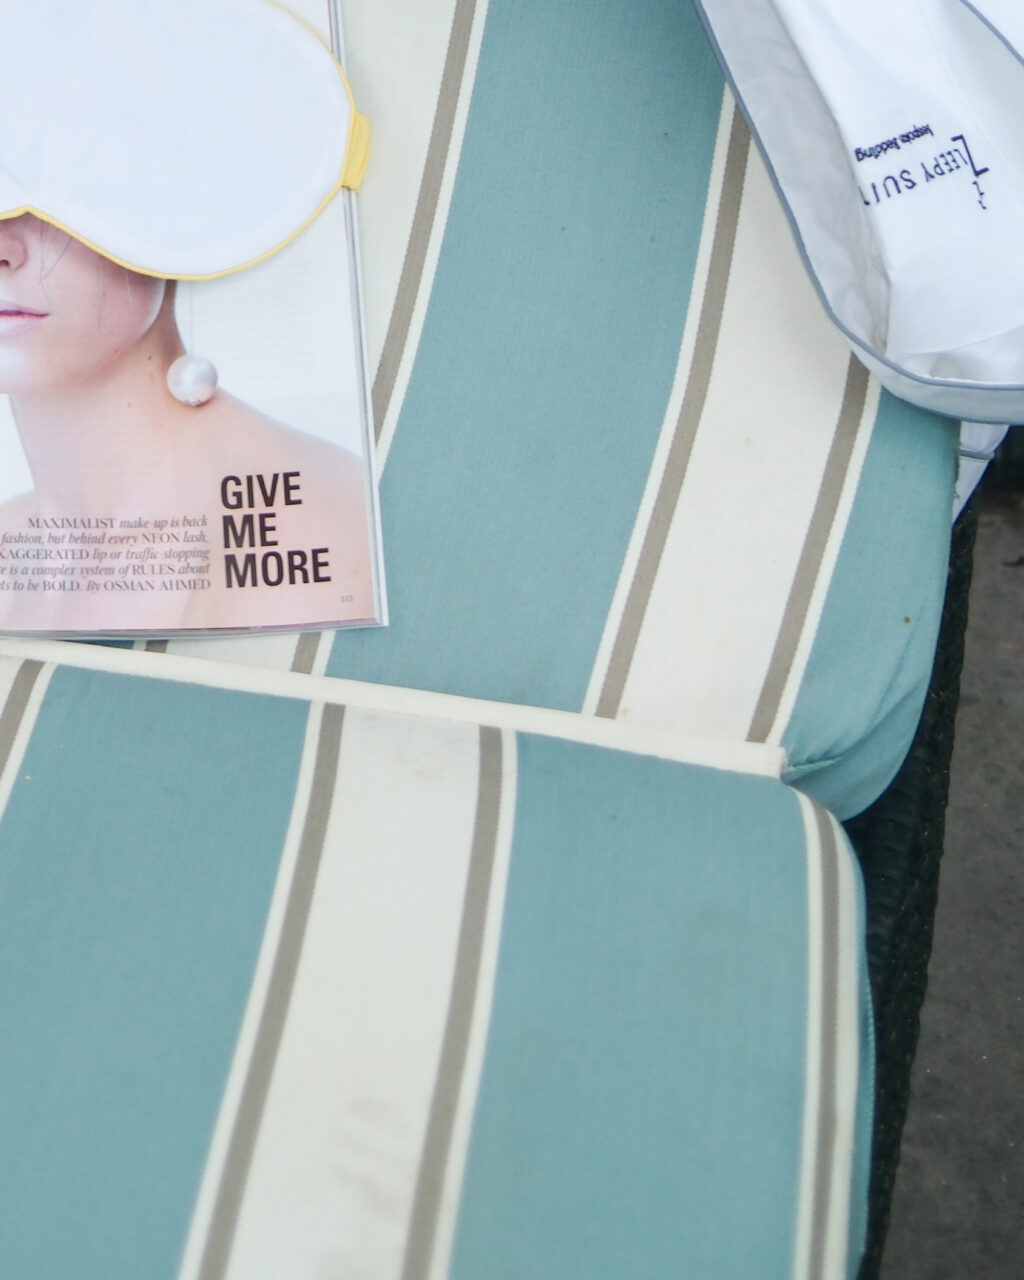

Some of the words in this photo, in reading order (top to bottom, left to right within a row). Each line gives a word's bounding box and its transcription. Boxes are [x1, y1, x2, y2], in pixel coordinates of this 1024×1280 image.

[220, 471, 303, 509] GIVE
[27, 517, 116, 529] MAXIMALIST
[170, 517, 179, 528] is
[182, 514, 208, 527] back
[222, 512, 278, 549] ME
[0, 531, 44, 547] fashion,
[47, 532, 66, 544] but
[68, 532, 106, 544] behind
[107, 535, 138, 547] every
[141, 532, 180, 543] NEON
[92, 548, 107, 563] lip
[109, 550, 123, 560] or
[9, 563, 18, 575] is
[21, 566, 29, 575] a
[31, 563, 75, 579] complex
[79, 565, 116, 579] system
[118, 563, 130, 579] of
[132, 564, 176, 576] RULES
[178, 562, 210, 575] about
[224, 547, 332, 589] MORE
[12, 580, 24, 591] to
[27, 578, 40, 591] be
[42, 580, 82, 592] BOLD.
[86, 580, 100, 594] By
[103, 579, 155, 592] OSMAN
[159, 578, 212, 592] AHMED
